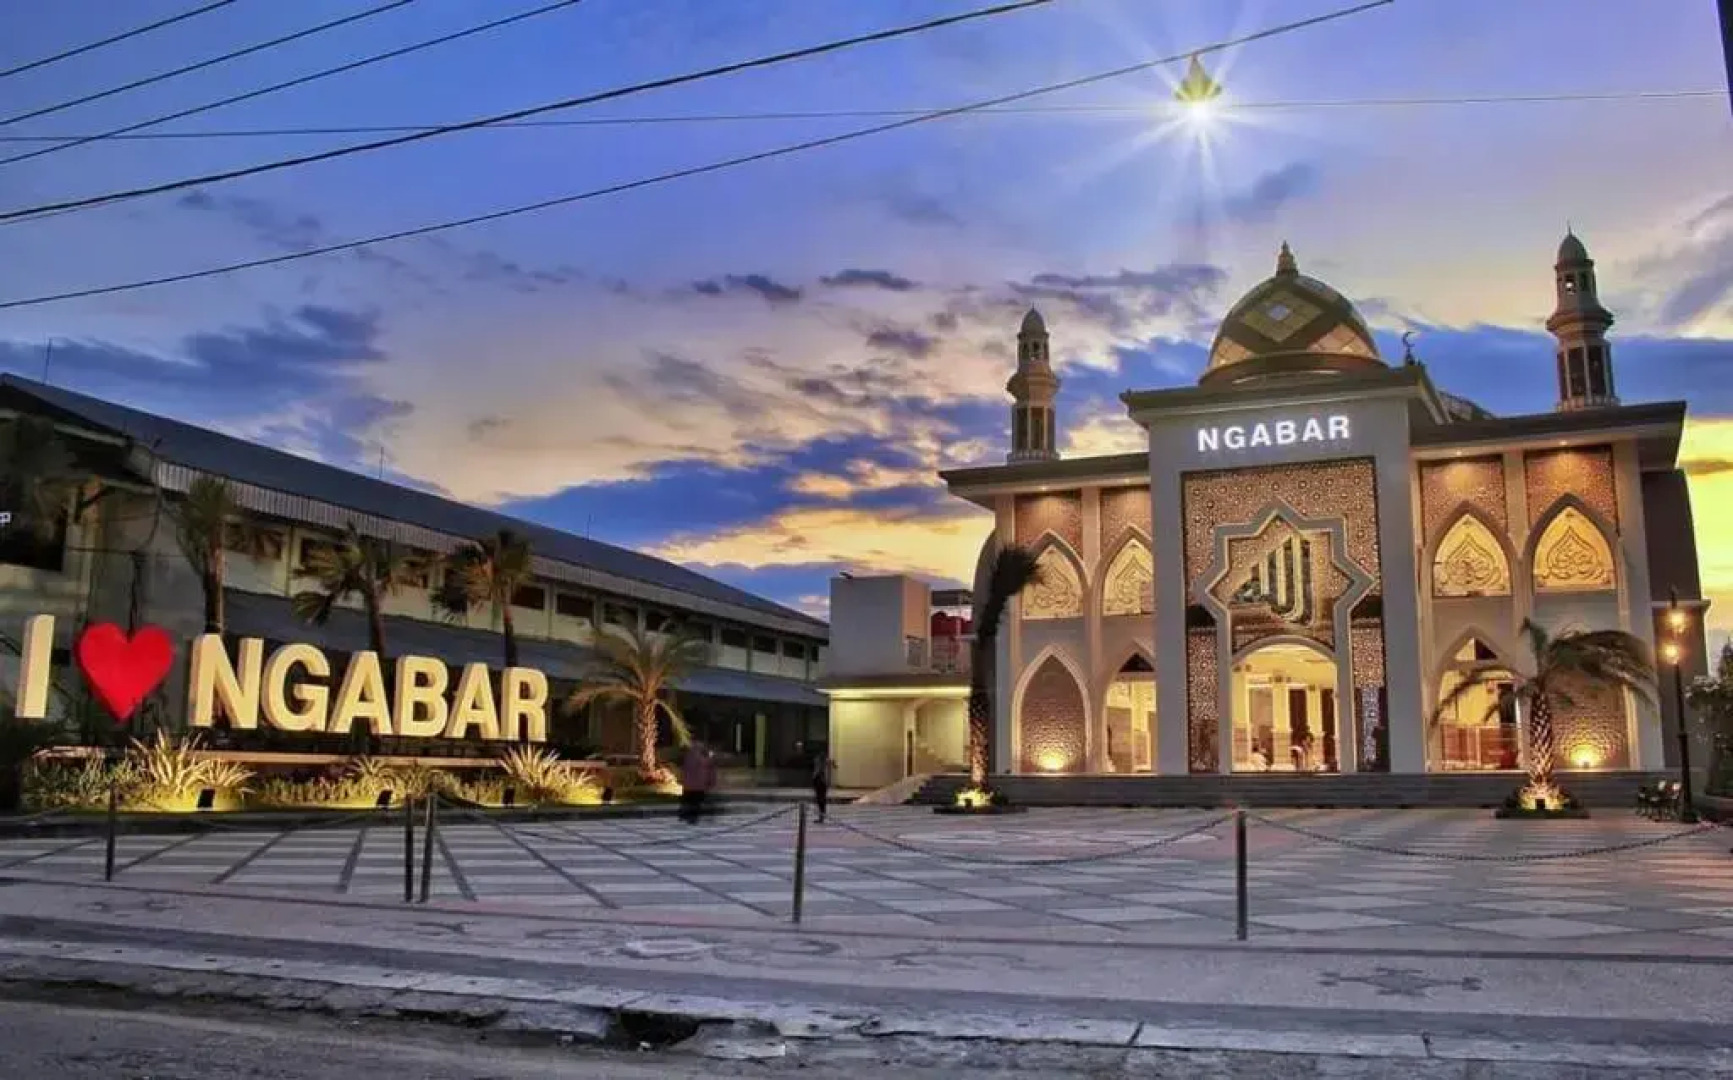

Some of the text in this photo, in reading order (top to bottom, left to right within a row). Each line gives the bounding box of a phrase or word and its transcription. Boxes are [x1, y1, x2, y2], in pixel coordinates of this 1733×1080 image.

[1197, 415, 1350, 452] NGABAR
[16, 614, 549, 742] I NGABAR
